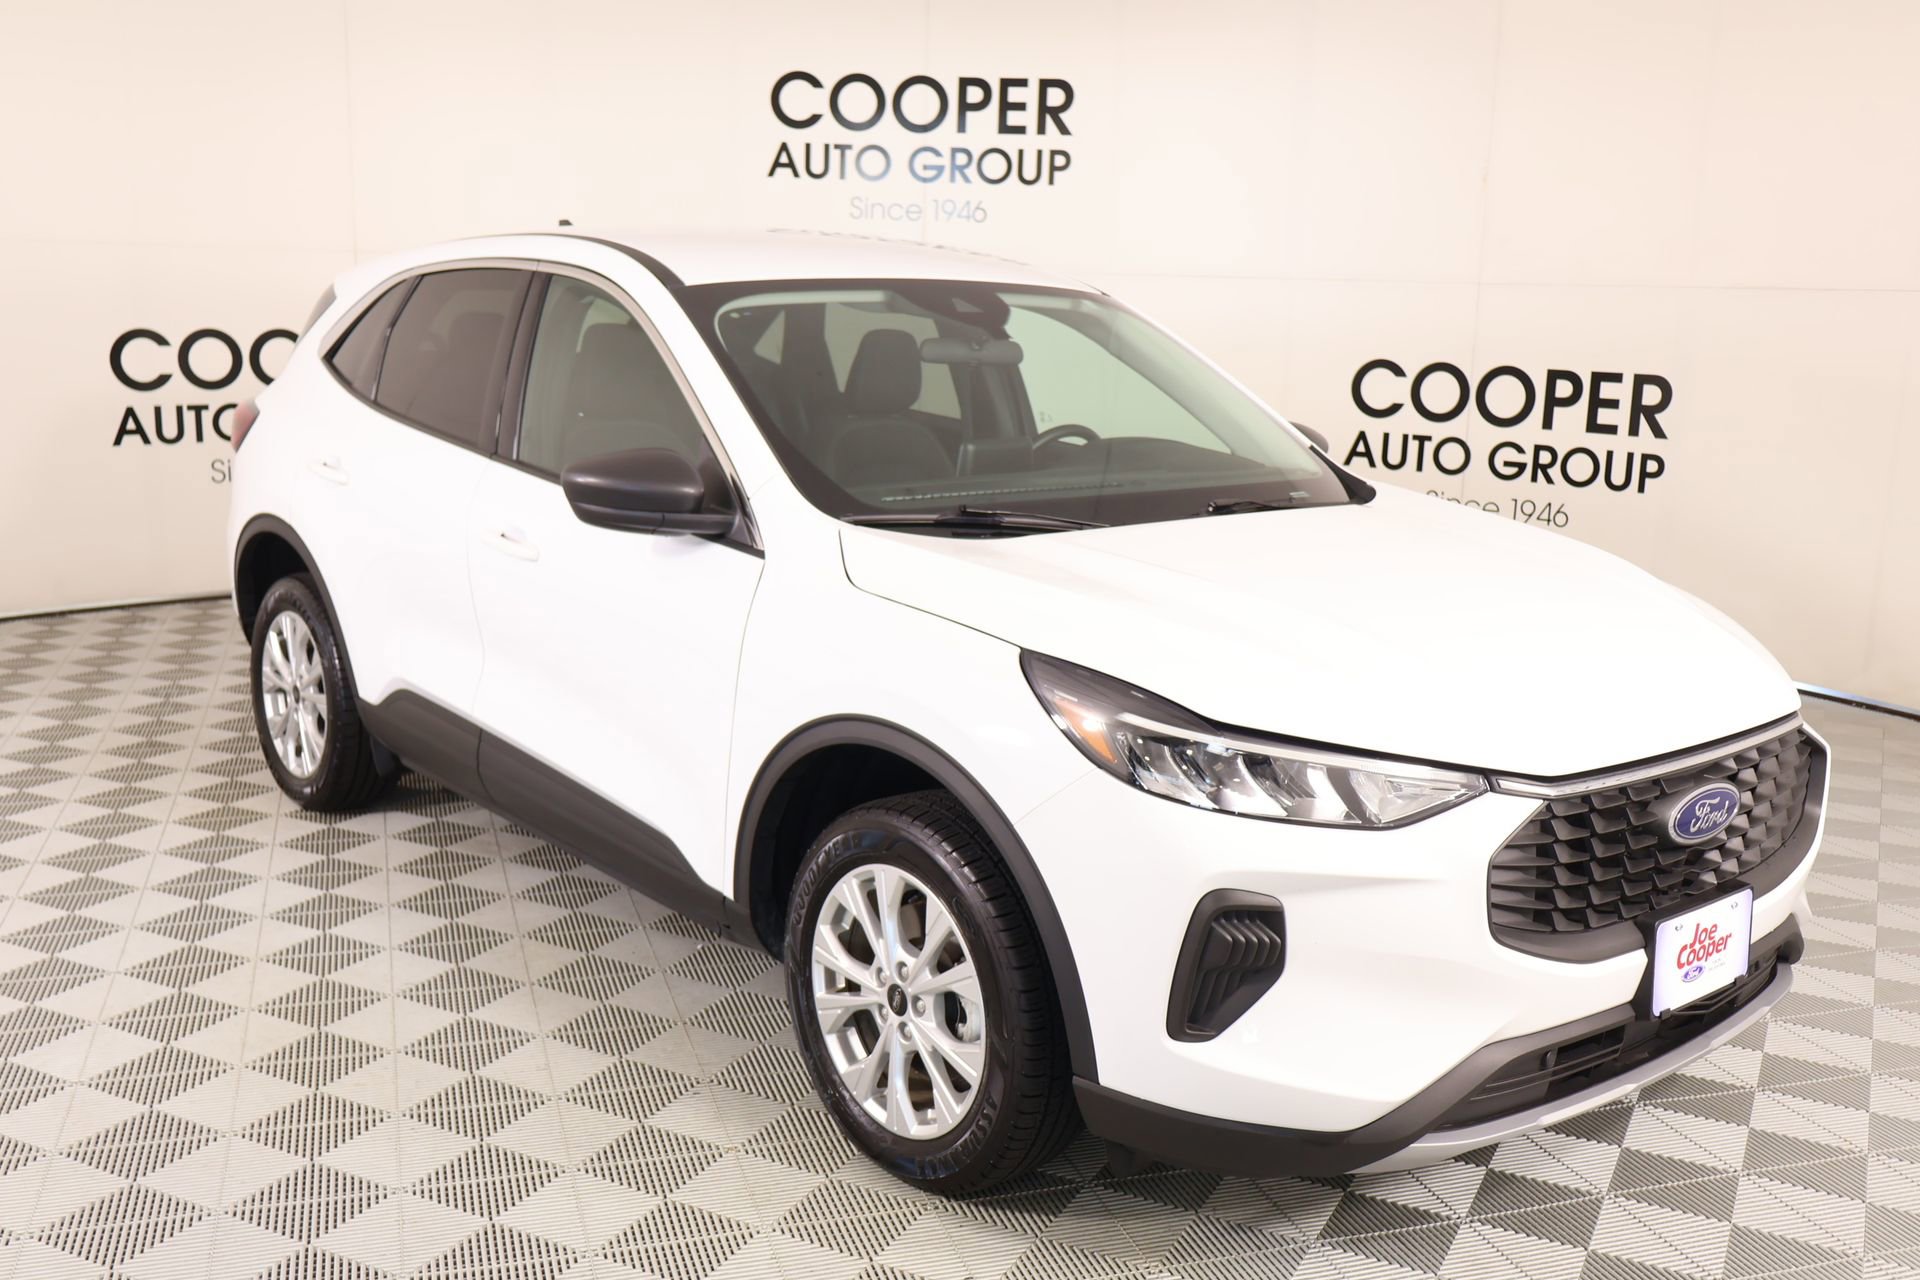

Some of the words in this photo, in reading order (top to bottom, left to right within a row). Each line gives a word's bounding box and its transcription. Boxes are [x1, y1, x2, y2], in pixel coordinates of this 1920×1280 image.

[771, 71, 1074, 135] COOPER
[767, 141, 891, 182] AUTO
[908, 146, 1071, 186] GROUP
[849, 195, 922, 222] Since
[931, 199, 988, 223] 1946
[1351, 358, 1673, 440] COOPER
[1343, 430, 1471, 476] AUTO
[1488, 441, 1666, 494] GROUP
[1511, 498, 1569, 528] 1946
[1690, 796, 1729, 833] Ford
[1676, 932, 1732, 970] Cooper
[1689, 922, 1718, 949] Joe
